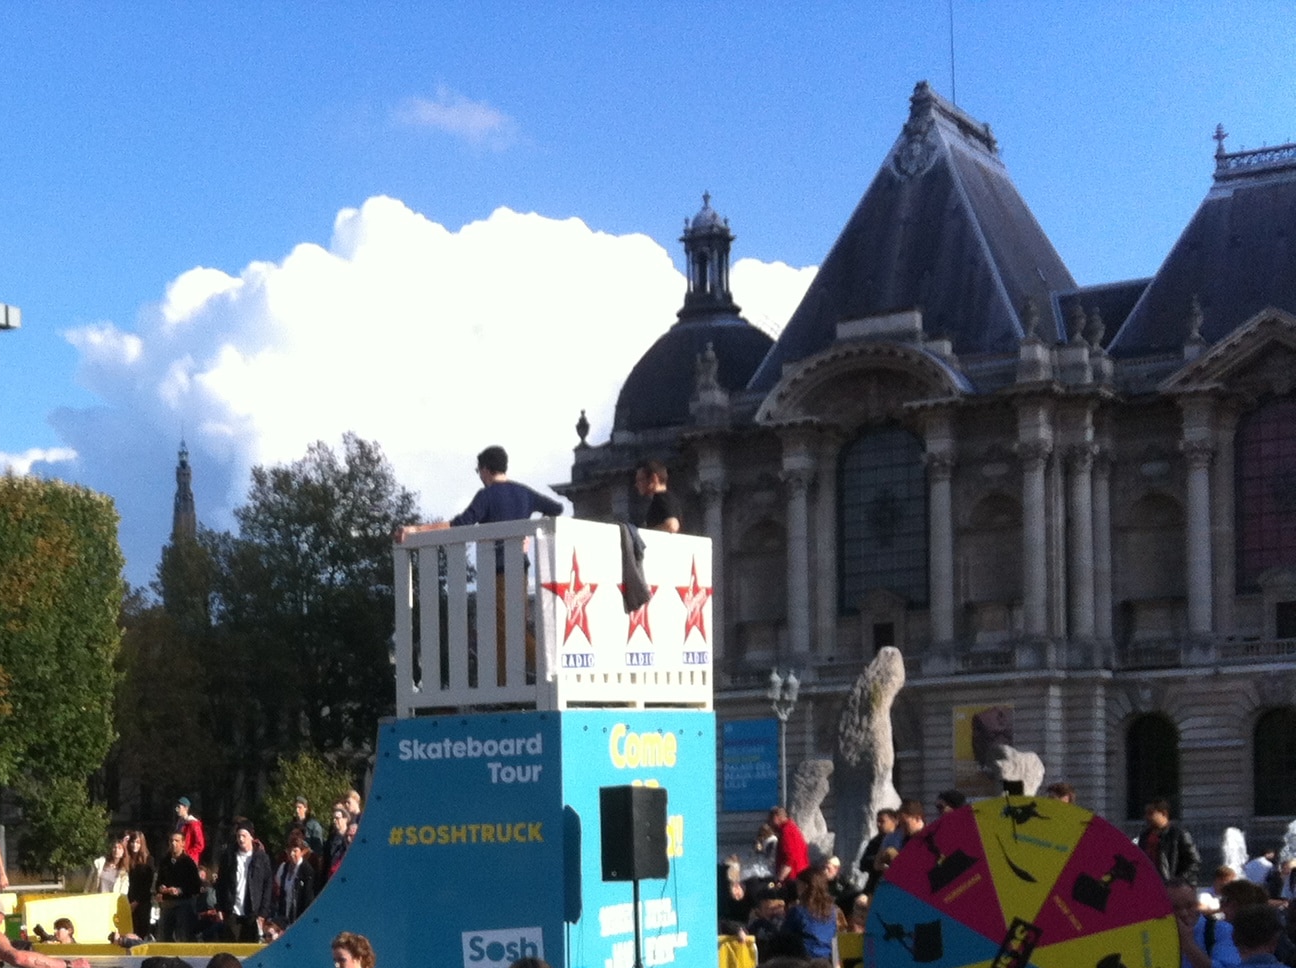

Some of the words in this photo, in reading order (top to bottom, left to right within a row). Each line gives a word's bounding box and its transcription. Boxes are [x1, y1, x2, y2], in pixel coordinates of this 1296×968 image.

[562, 653, 595, 668] RADIO
[398, 733, 543, 761] Skateboard
[609, 722, 677, 769] Come
[487, 762, 543, 784] Tour
[388, 822, 545, 846] #SOSHTRUCK
[469, 935, 539, 962] Sosh
